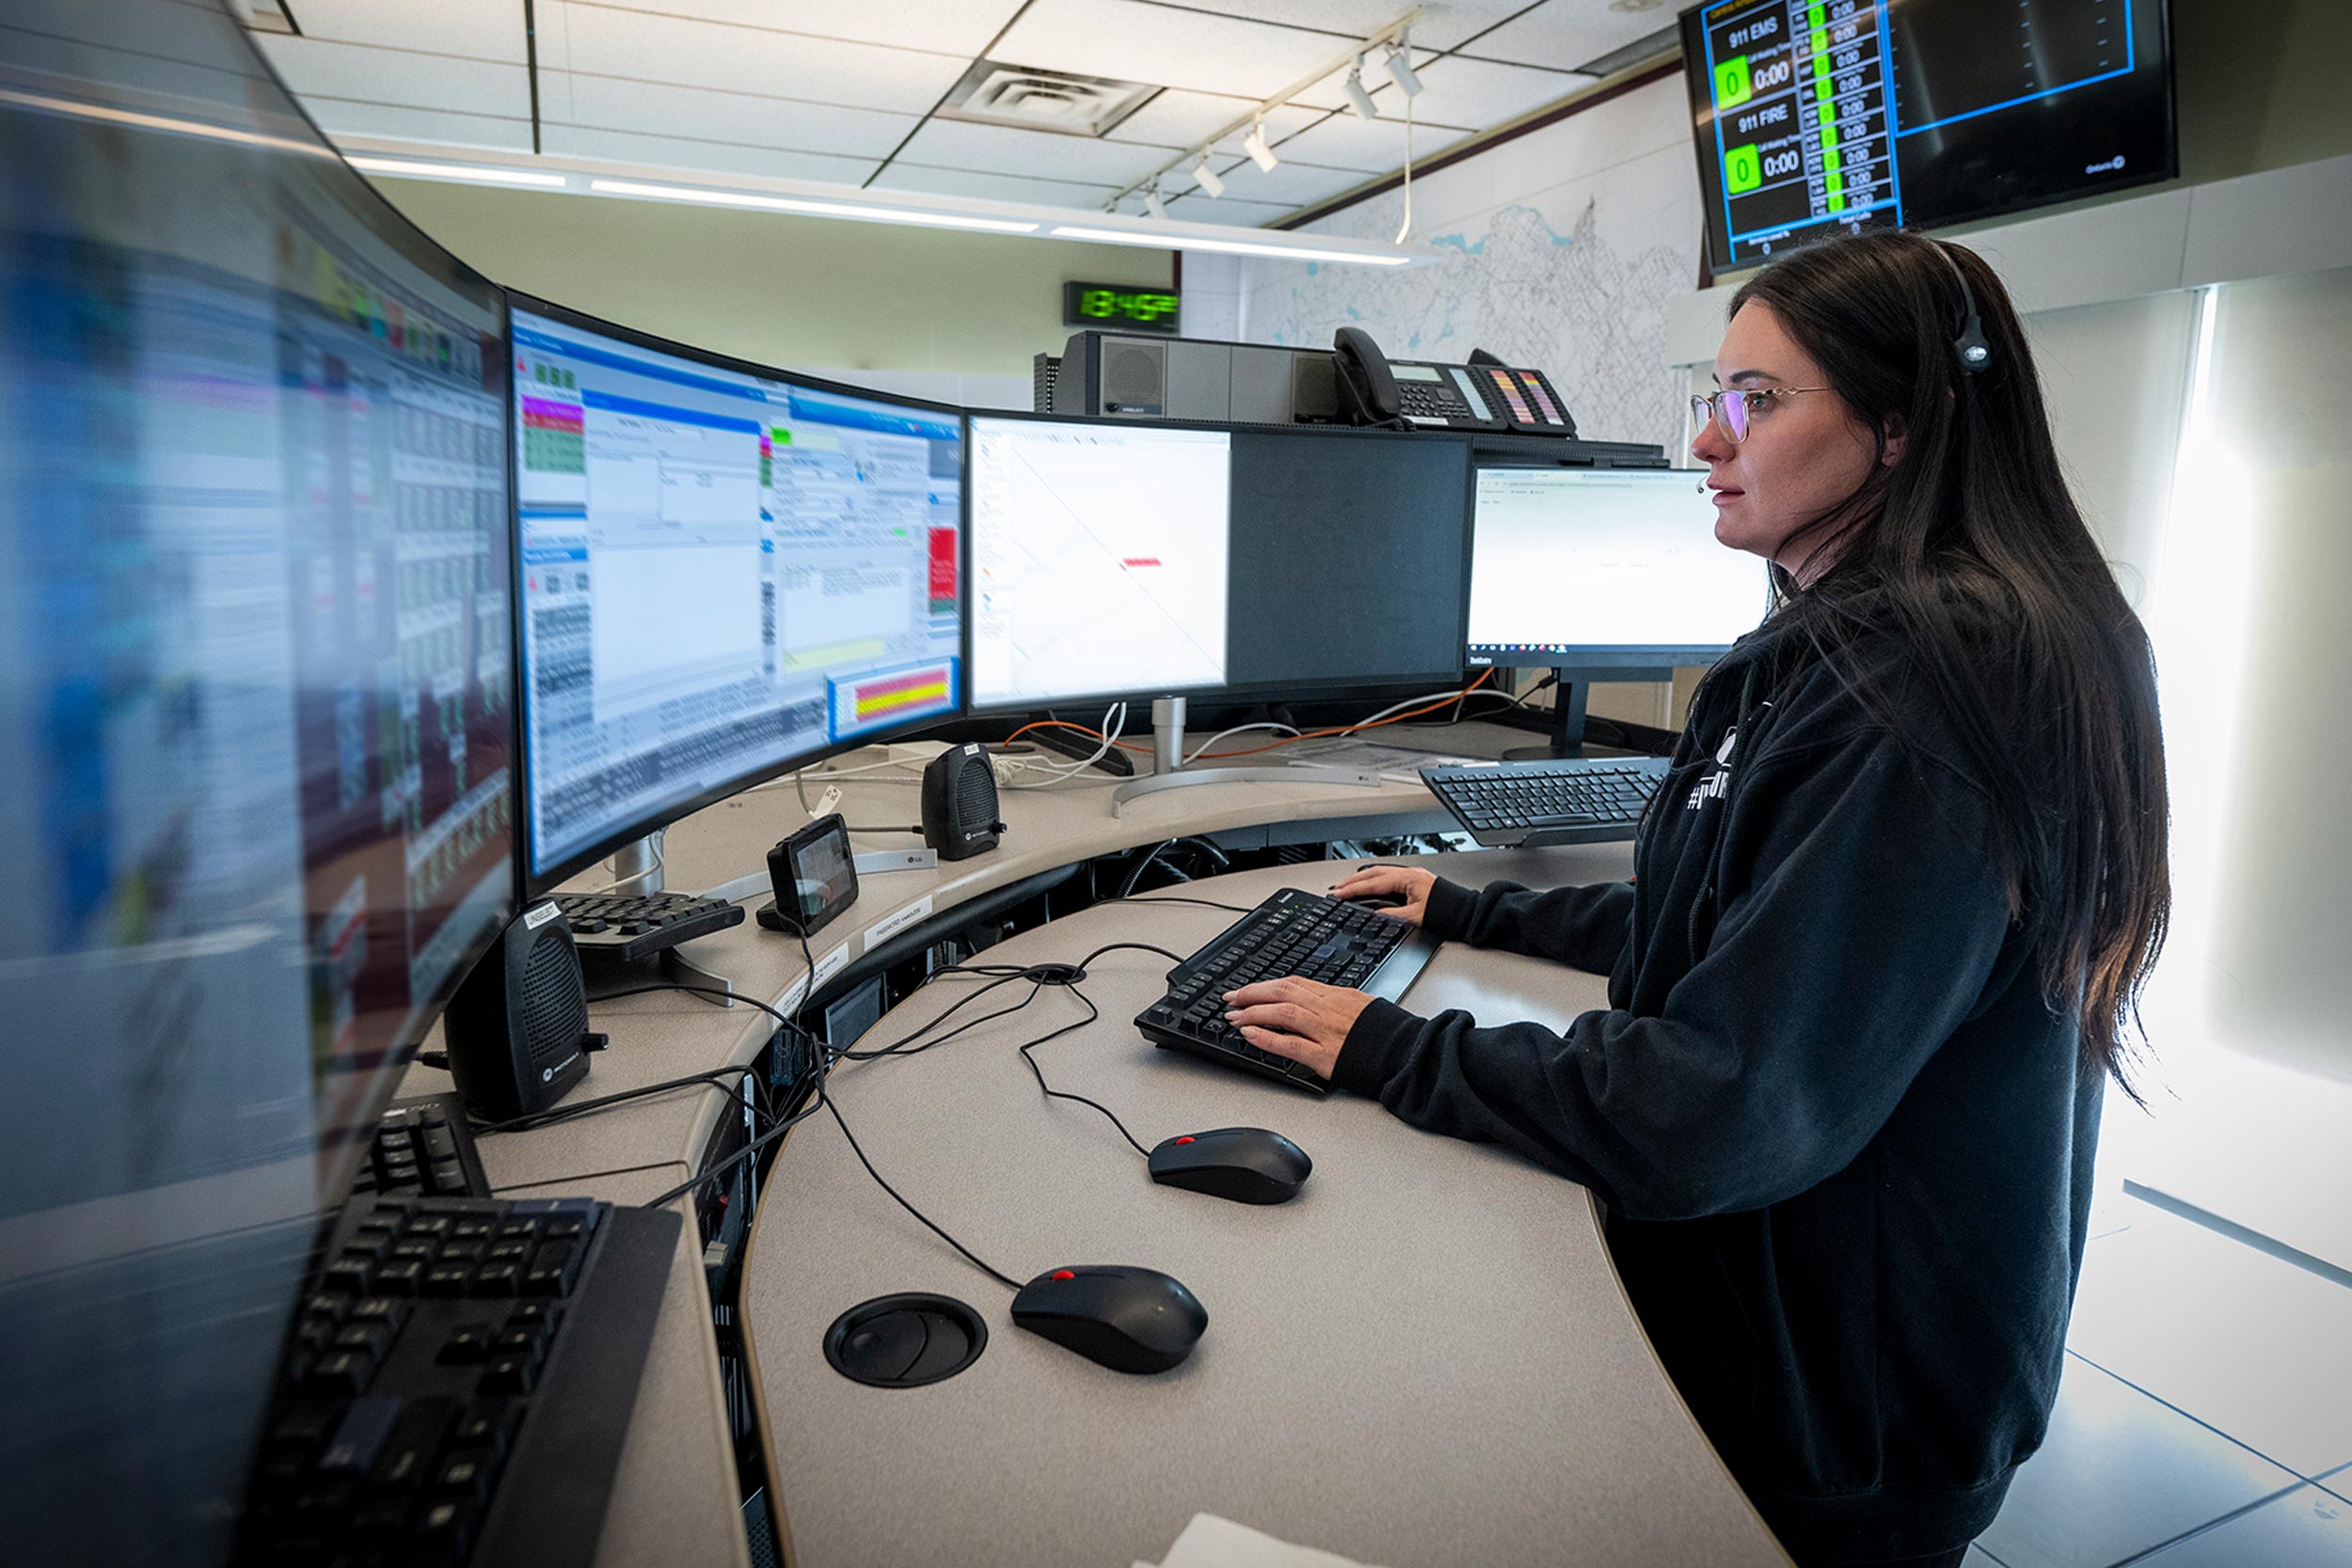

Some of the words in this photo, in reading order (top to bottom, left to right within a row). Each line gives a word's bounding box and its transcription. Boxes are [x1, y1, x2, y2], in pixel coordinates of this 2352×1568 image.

[1728, 28, 1749, 49] 911
[1750, 15, 1778, 40] EMS
[1726, 71, 1739, 96] 0
[1754, 60, 1789, 90] 0:00
[1738, 114, 1758, 134] 911
[1758, 103, 1788, 128] FIRE
[1737, 158, 1749, 182] 0
[1764, 150, 1799, 177] 0:00
